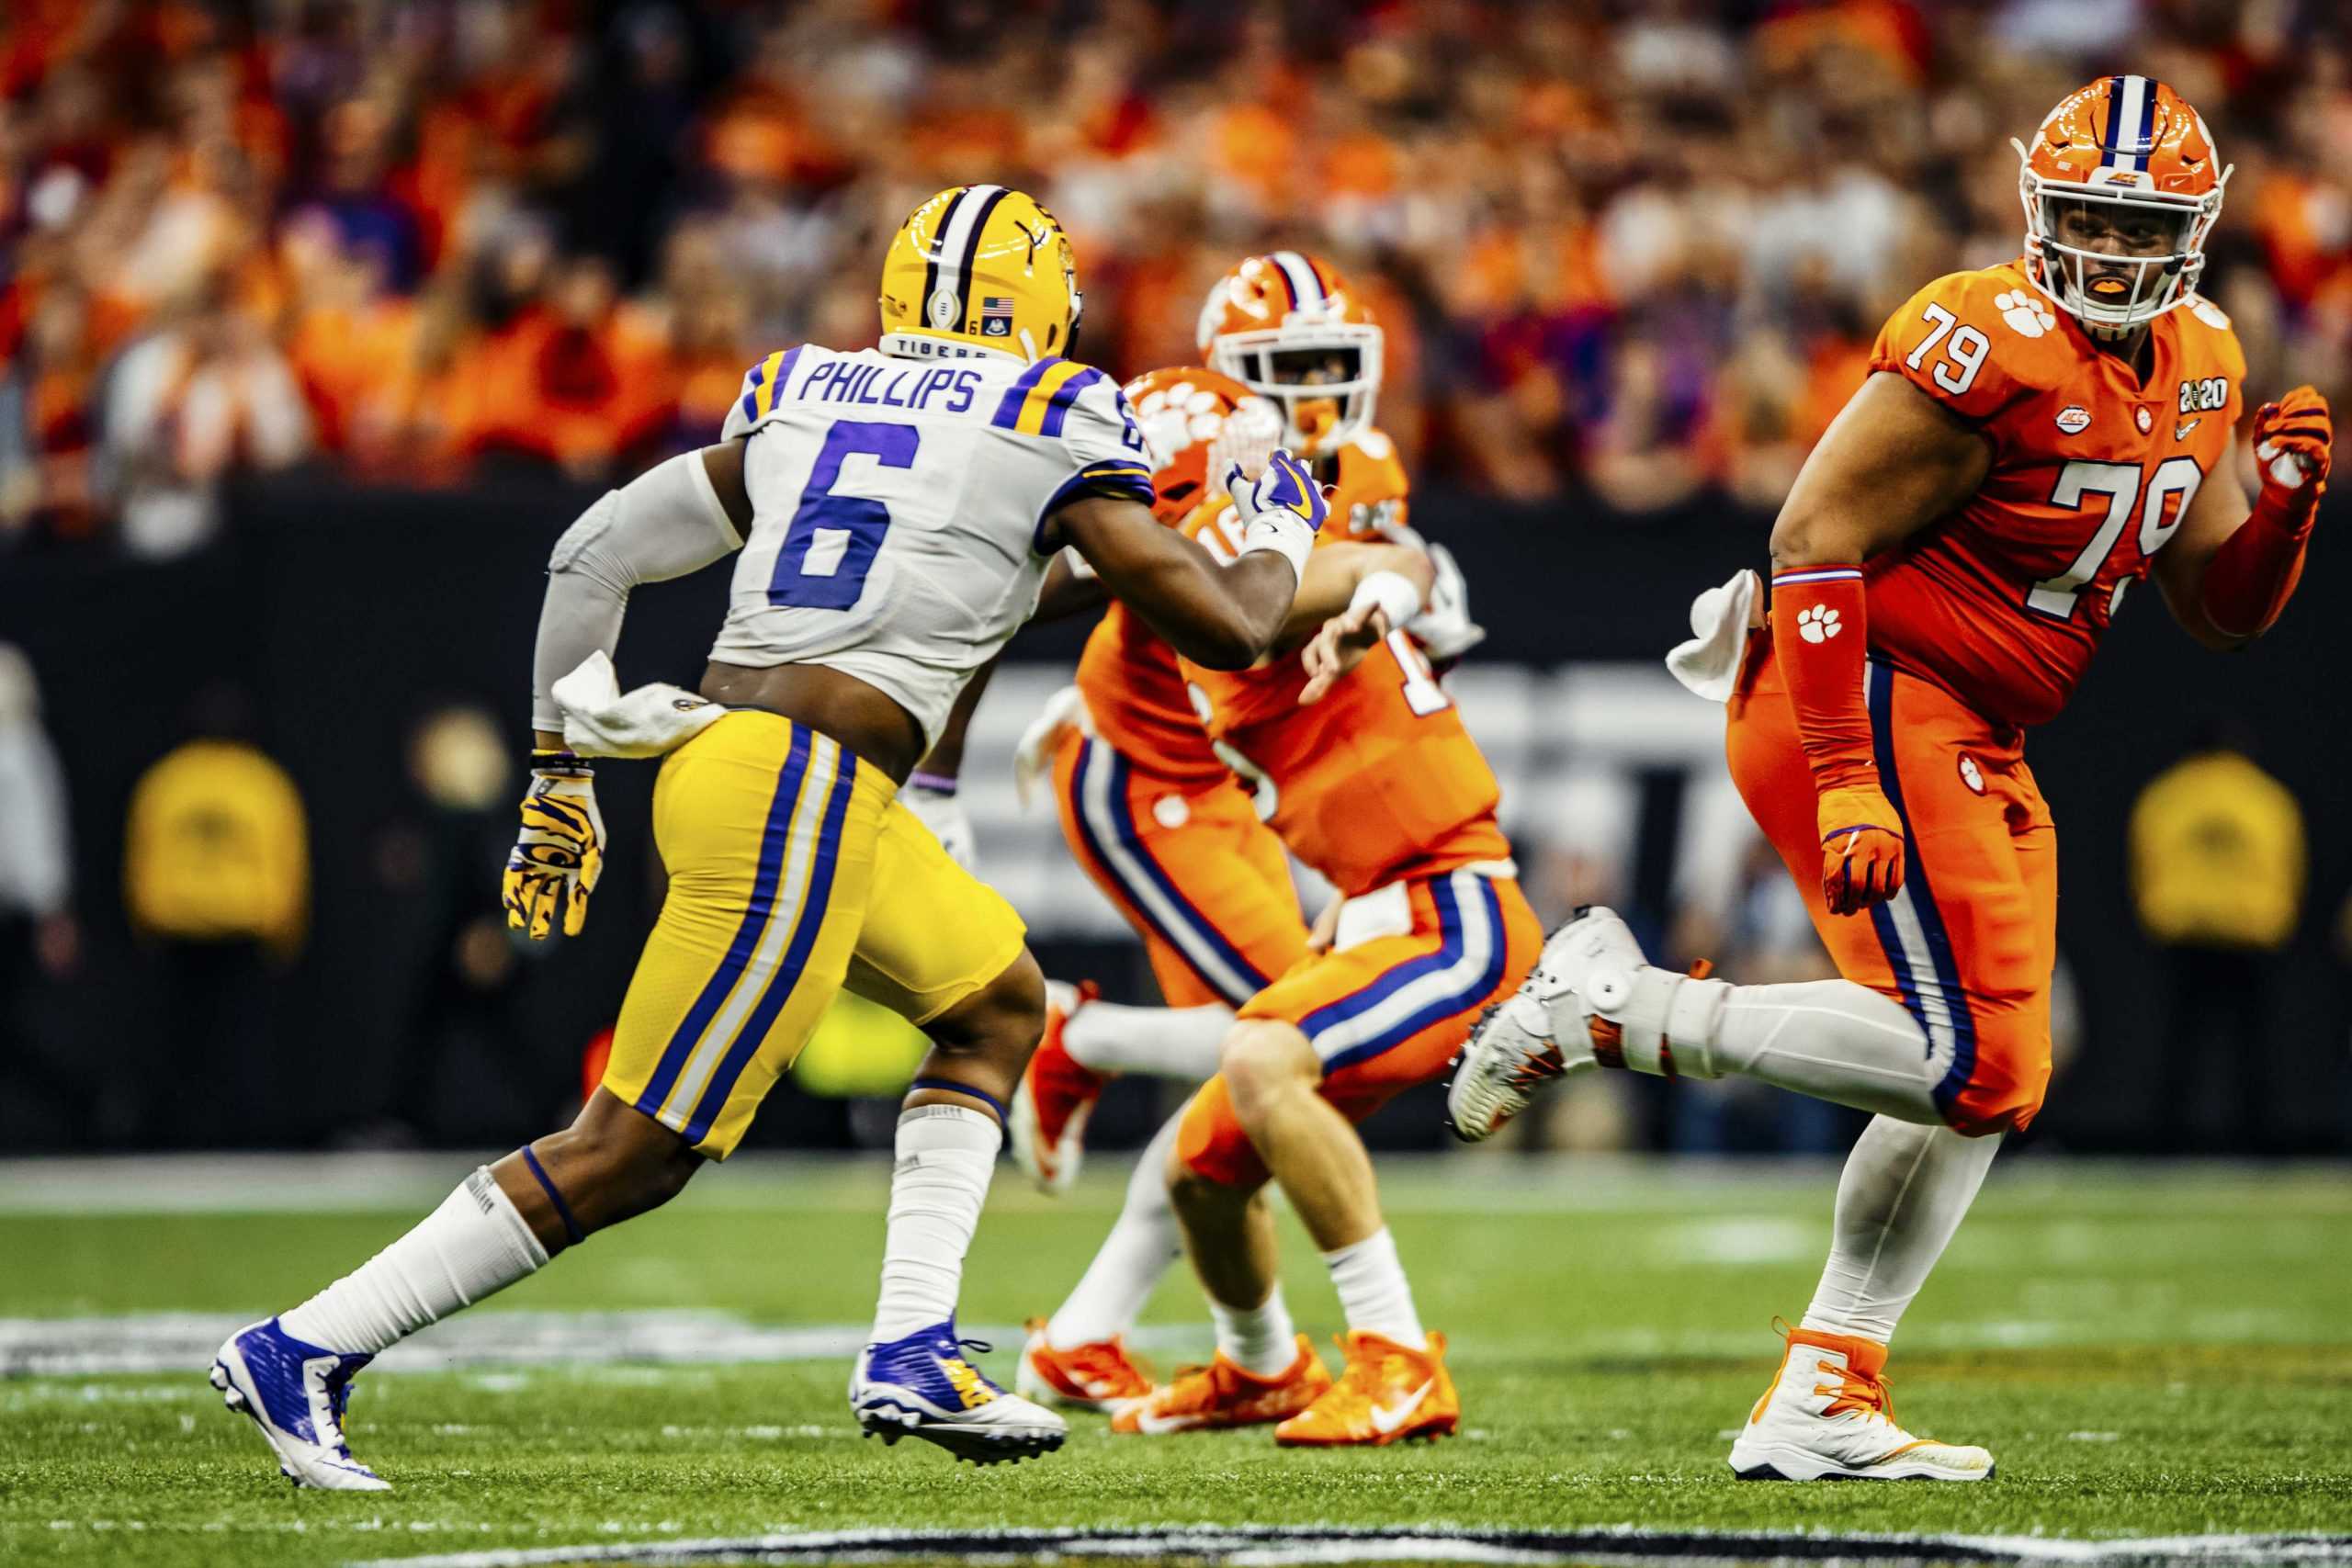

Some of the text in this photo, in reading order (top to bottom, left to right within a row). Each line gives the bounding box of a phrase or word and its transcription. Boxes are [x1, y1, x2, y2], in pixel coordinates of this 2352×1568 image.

[968, 321, 978, 335] 6
[1905, 301, 1991, 397] 79
[797, 361, 983, 412] PHILLIPS
[765, 420, 921, 612] 6
[2025, 455, 2205, 624] 79
